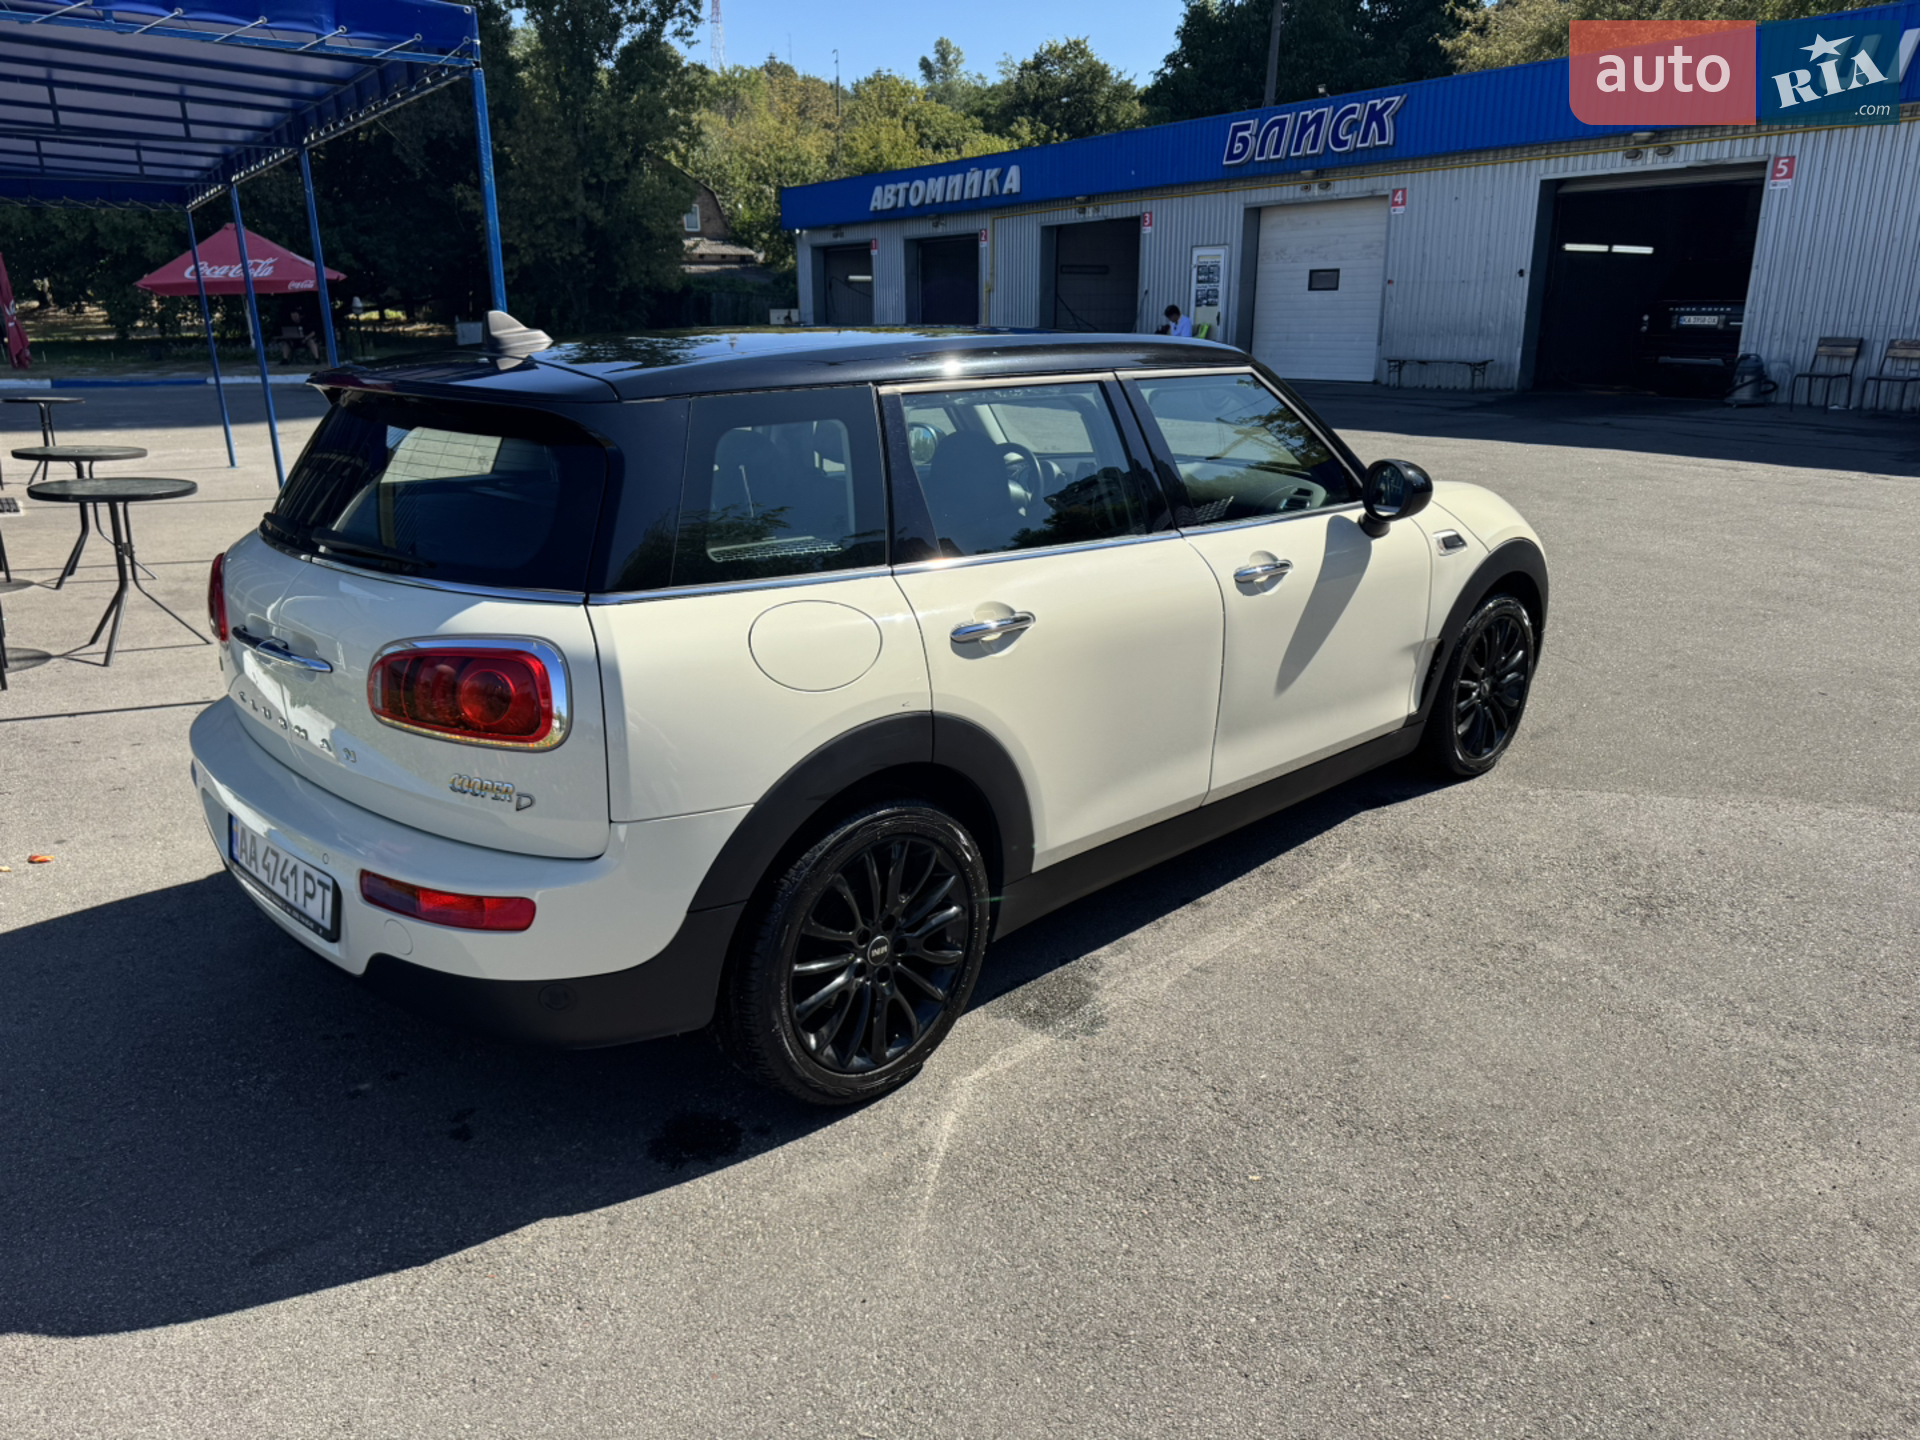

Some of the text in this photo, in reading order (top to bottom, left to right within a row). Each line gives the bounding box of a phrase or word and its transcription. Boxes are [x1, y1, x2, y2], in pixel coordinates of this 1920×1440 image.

[1222, 94, 1407, 166] БЛИСК
[1775, 158, 1790, 178] 5
[869, 164, 1021, 212] АВТОМИЙКА
[1393, 190, 1404, 205] 4
[1143, 212, 1150, 226] 3
[184, 256, 278, 280] Coca-Cola
[448, 772, 536, 812] COOPER D
[240, 826, 259, 874] AA
[261, 845, 299, 903] 4741
[303, 868, 331, 920] PT
